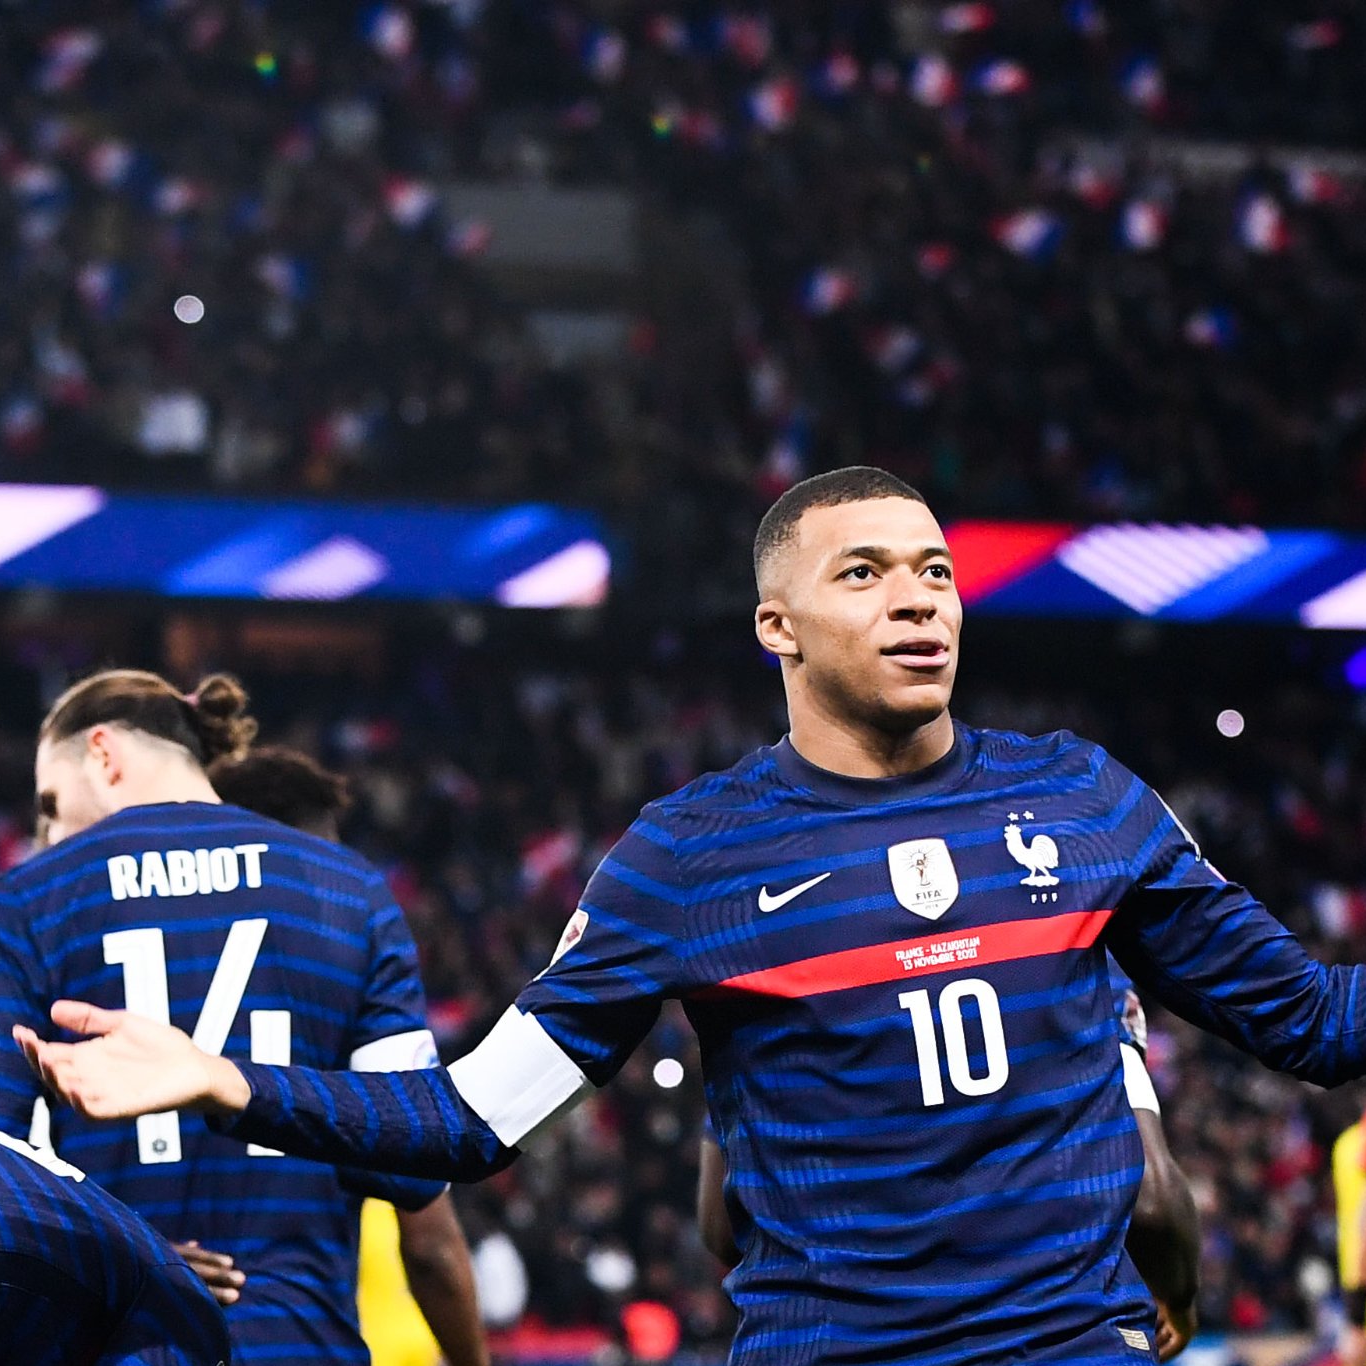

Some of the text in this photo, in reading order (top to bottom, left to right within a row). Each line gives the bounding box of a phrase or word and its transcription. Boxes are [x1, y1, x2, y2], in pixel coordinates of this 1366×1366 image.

[107, 843, 269, 900] RABIOT
[916, 890, 941, 900] FIFA
[895, 946, 924, 961] FRANCE
[913, 951, 955, 968] NOVEMBRE
[102, 918, 291, 1164] 14
[898, 978, 1010, 1107] 10
